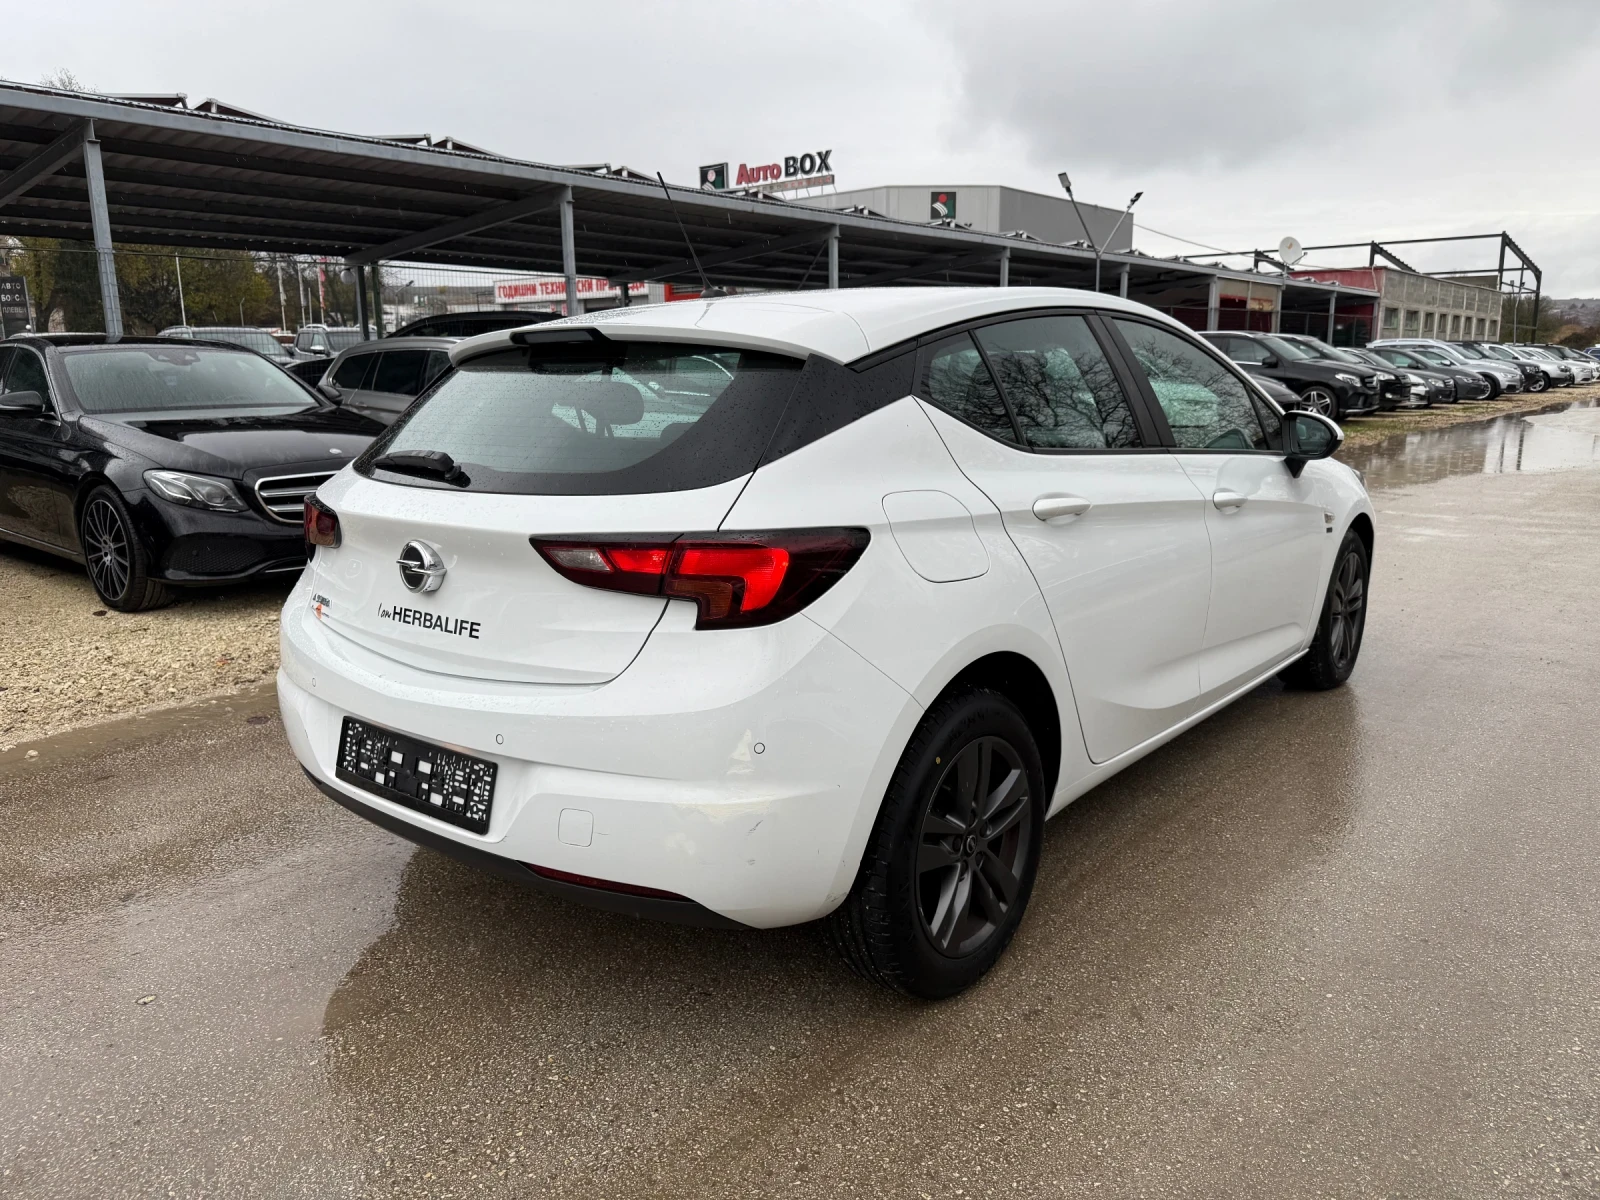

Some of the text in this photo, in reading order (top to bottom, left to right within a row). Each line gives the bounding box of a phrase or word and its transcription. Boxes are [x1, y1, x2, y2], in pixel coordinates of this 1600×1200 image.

[784, 149, 832, 178] BOX
[498, 283, 537, 299] ГОДИШНИ
[539, 278, 593, 296] ТЕХНИСКИ
[392, 605, 481, 639] HERBALIFE
